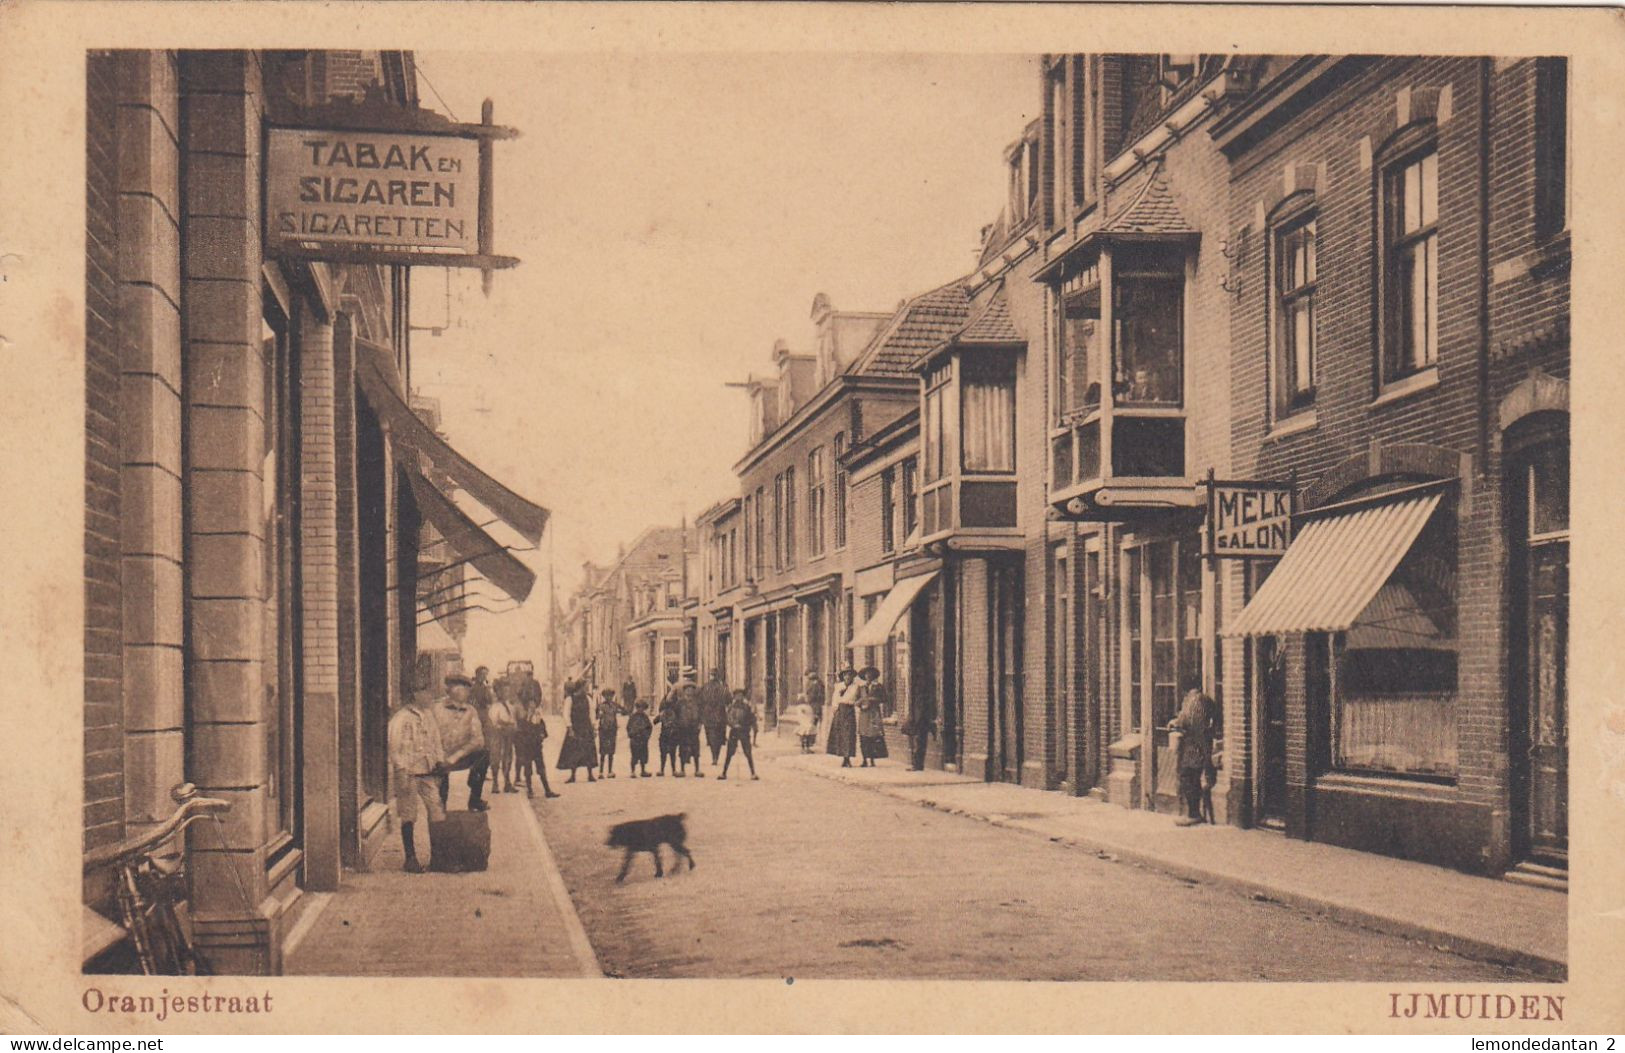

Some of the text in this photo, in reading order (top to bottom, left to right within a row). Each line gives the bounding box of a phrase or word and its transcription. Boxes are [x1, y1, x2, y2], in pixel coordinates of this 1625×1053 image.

[303, 140, 461, 173] TABAK EN
[300, 176, 455, 208] SIGAREN
[1218, 491, 1287, 531] MELK
[1218, 521, 1287, 549] SALON
